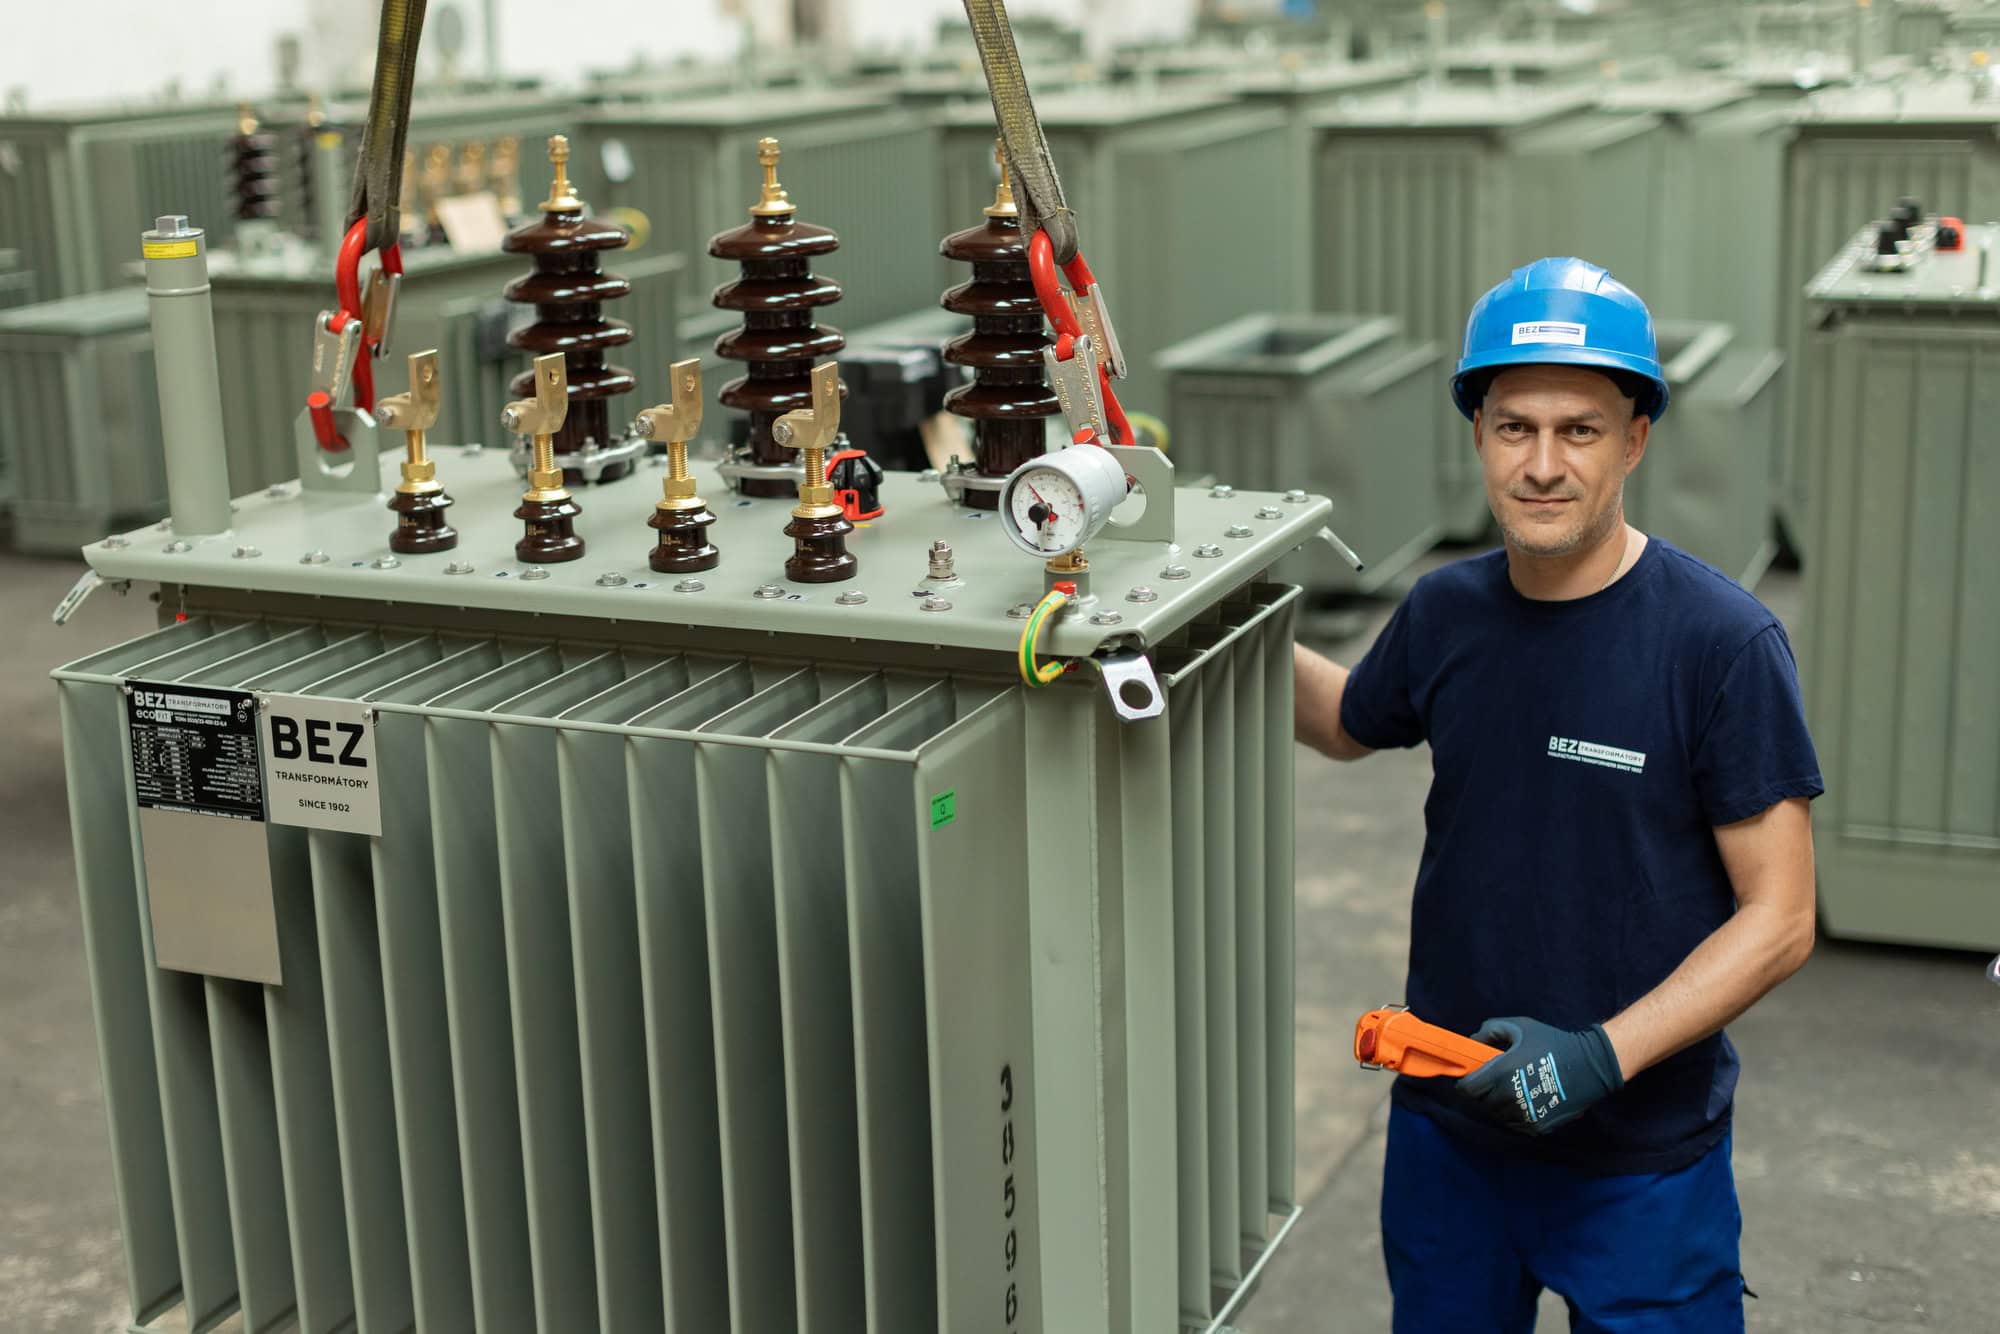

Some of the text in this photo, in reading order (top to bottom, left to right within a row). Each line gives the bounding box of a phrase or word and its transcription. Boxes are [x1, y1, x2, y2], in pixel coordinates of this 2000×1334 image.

[1518, 325, 1538, 335] BEZ
[134, 690, 166, 709] BEZ
[270, 715, 368, 768] BEZ
[1548, 735, 1578, 754] BEZ
[275, 770, 369, 789] TRANSFORMÁTORY
[298, 799, 350, 813] SINCE 1902
[1000, 1063, 1018, 1334] 38596
